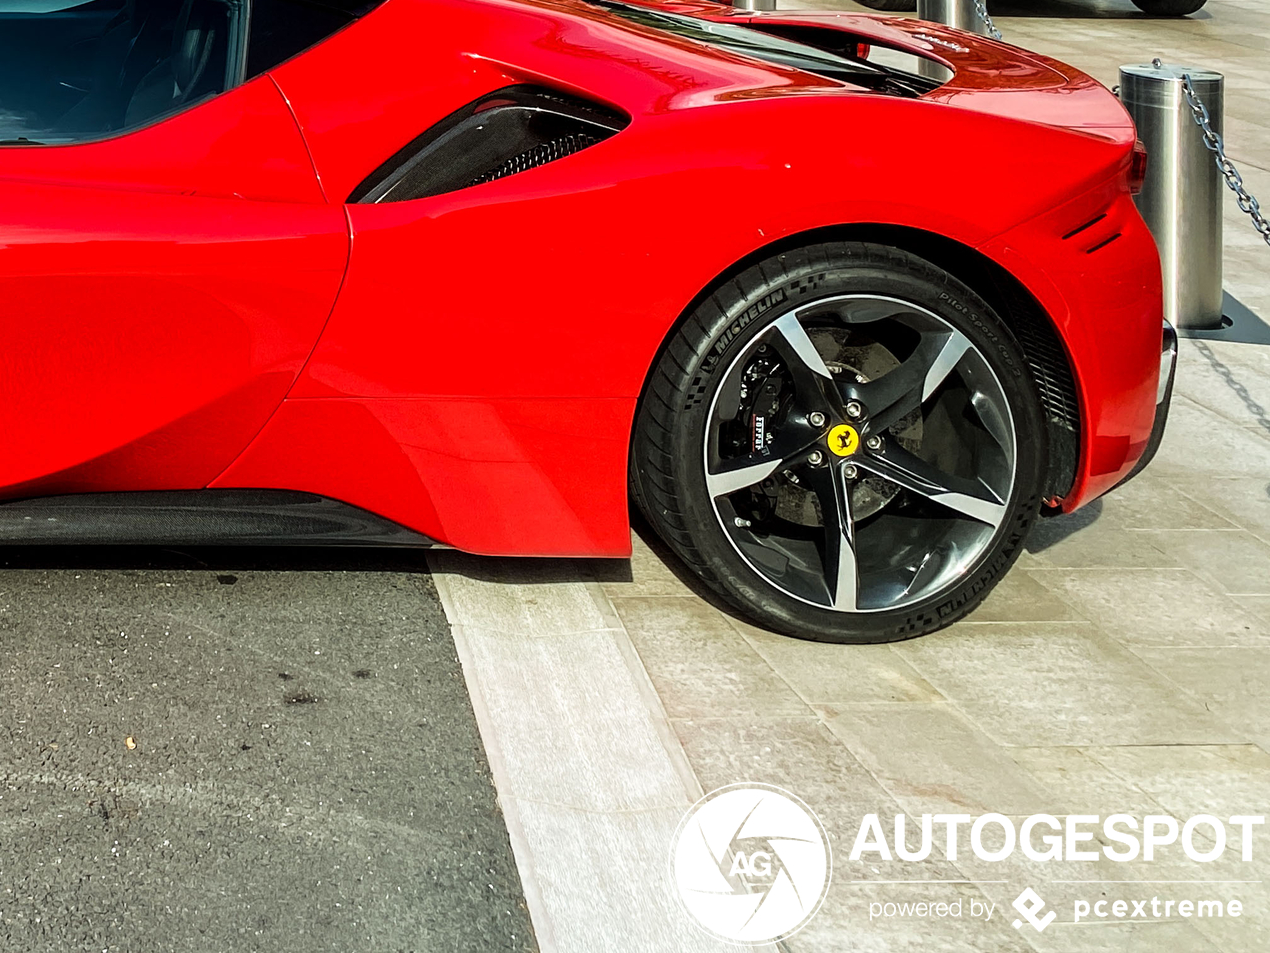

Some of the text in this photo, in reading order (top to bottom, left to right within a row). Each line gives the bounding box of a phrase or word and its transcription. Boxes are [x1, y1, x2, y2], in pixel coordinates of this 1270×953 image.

[715, 288, 785, 354] MICHELIN
[939, 292, 968, 314] Pilot
[969, 313, 998, 342] Sport
[755, 416, 764, 450] Ferrar
[937, 547, 1014, 619] MICHELIN
